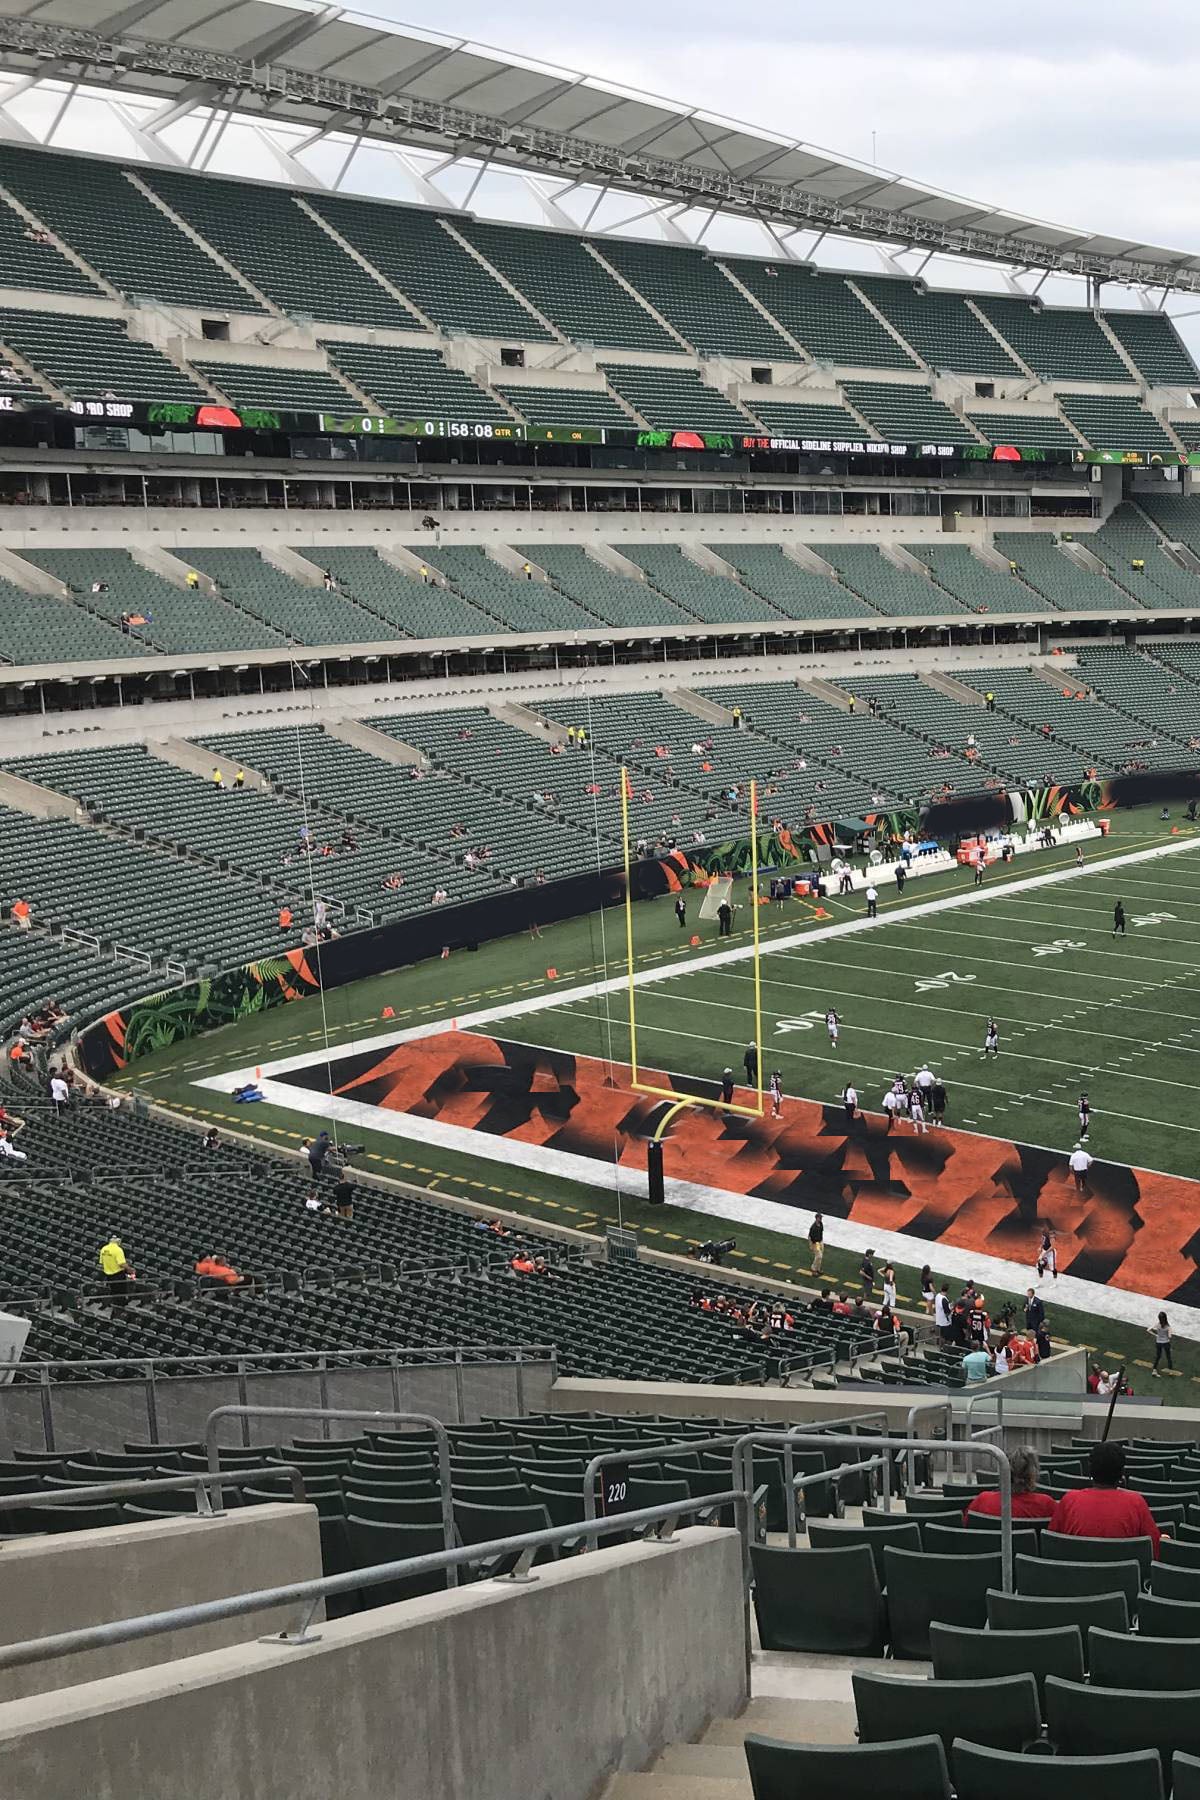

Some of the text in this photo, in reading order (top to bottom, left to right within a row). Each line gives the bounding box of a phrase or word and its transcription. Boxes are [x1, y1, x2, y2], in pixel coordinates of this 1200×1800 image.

[106, 403, 133, 417] SHOP
[361, 418, 372, 432] 0
[424, 421, 435, 435] 0
[450, 423, 493, 437] 58:08
[494, 428, 512, 436] QTR
[743, 437, 755, 448] BUY
[757, 438, 769, 448] THE
[770, 439, 800, 449] OFFICIAL
[801, 440, 831, 451] SIDELINE
[890, 445, 907, 455] SHOP
[938, 446, 954, 456] SHOP
[1131, 912, 1177, 924] 40
[1031, 939, 1087, 954] 30
[914, 971, 976, 989] 20
[775, 1011, 844, 1030] 10
[770, 1318, 781, 1328] 14
[972, 1320, 982, 1331] 50
[608, 1482, 627, 1502] 220
